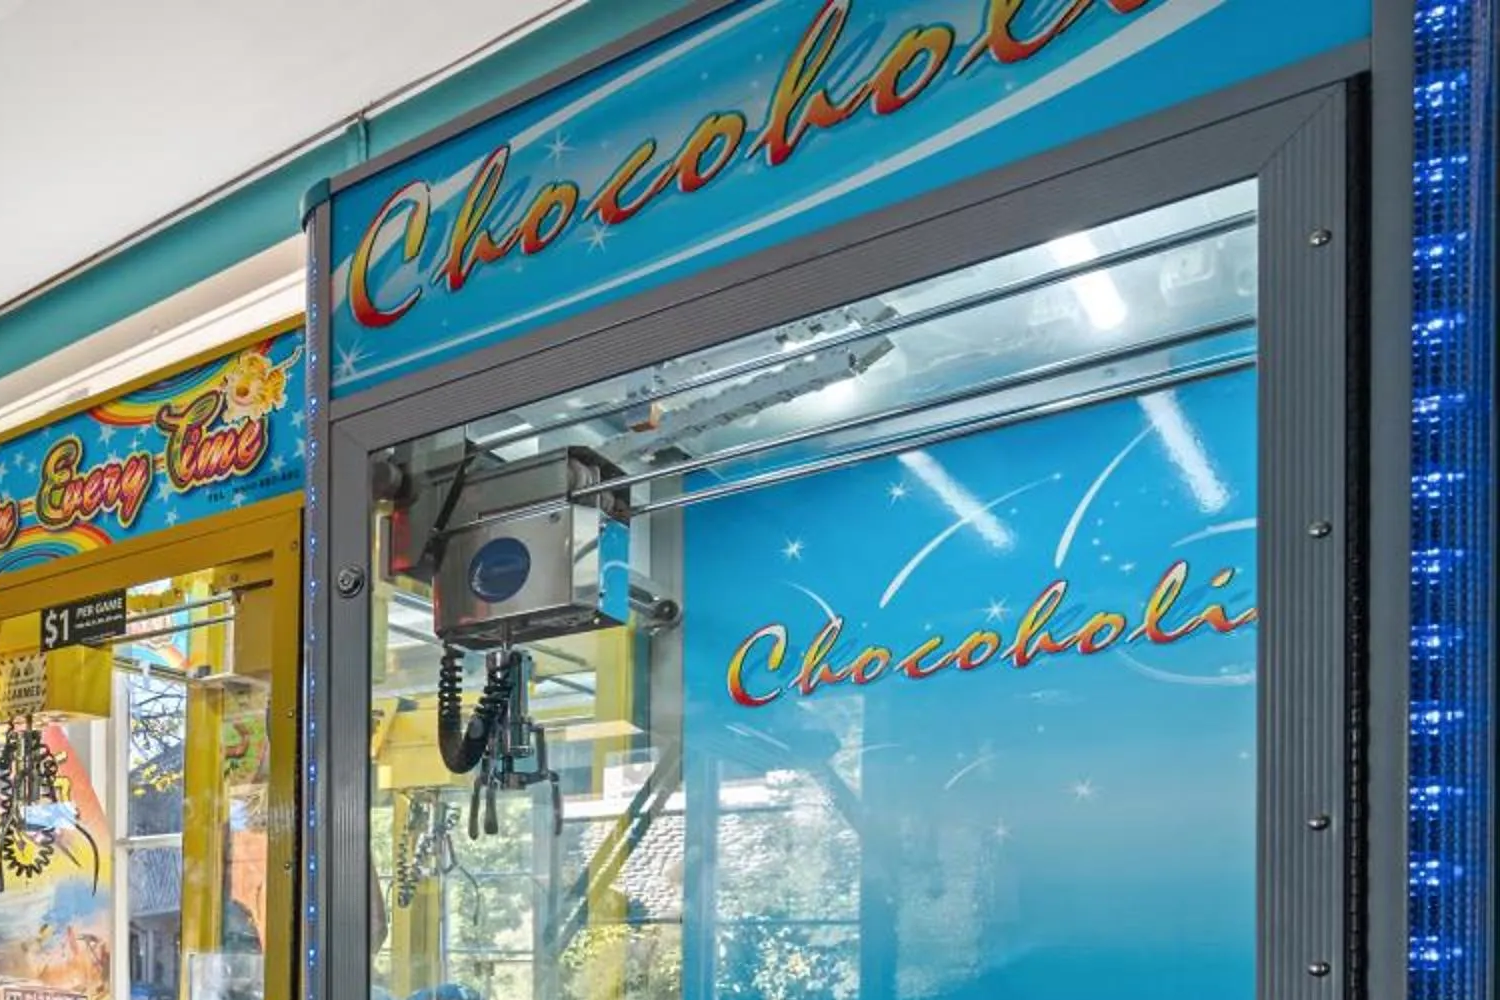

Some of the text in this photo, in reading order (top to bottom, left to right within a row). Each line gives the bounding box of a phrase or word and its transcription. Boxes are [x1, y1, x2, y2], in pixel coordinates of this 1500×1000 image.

[36, 434, 153, 528] Every
[154, 389, 269, 495] Time
[45, 609, 69, 648] $1
[95, 598, 123, 614] GAME
[727, 560, 1258, 708] Chocoholi
